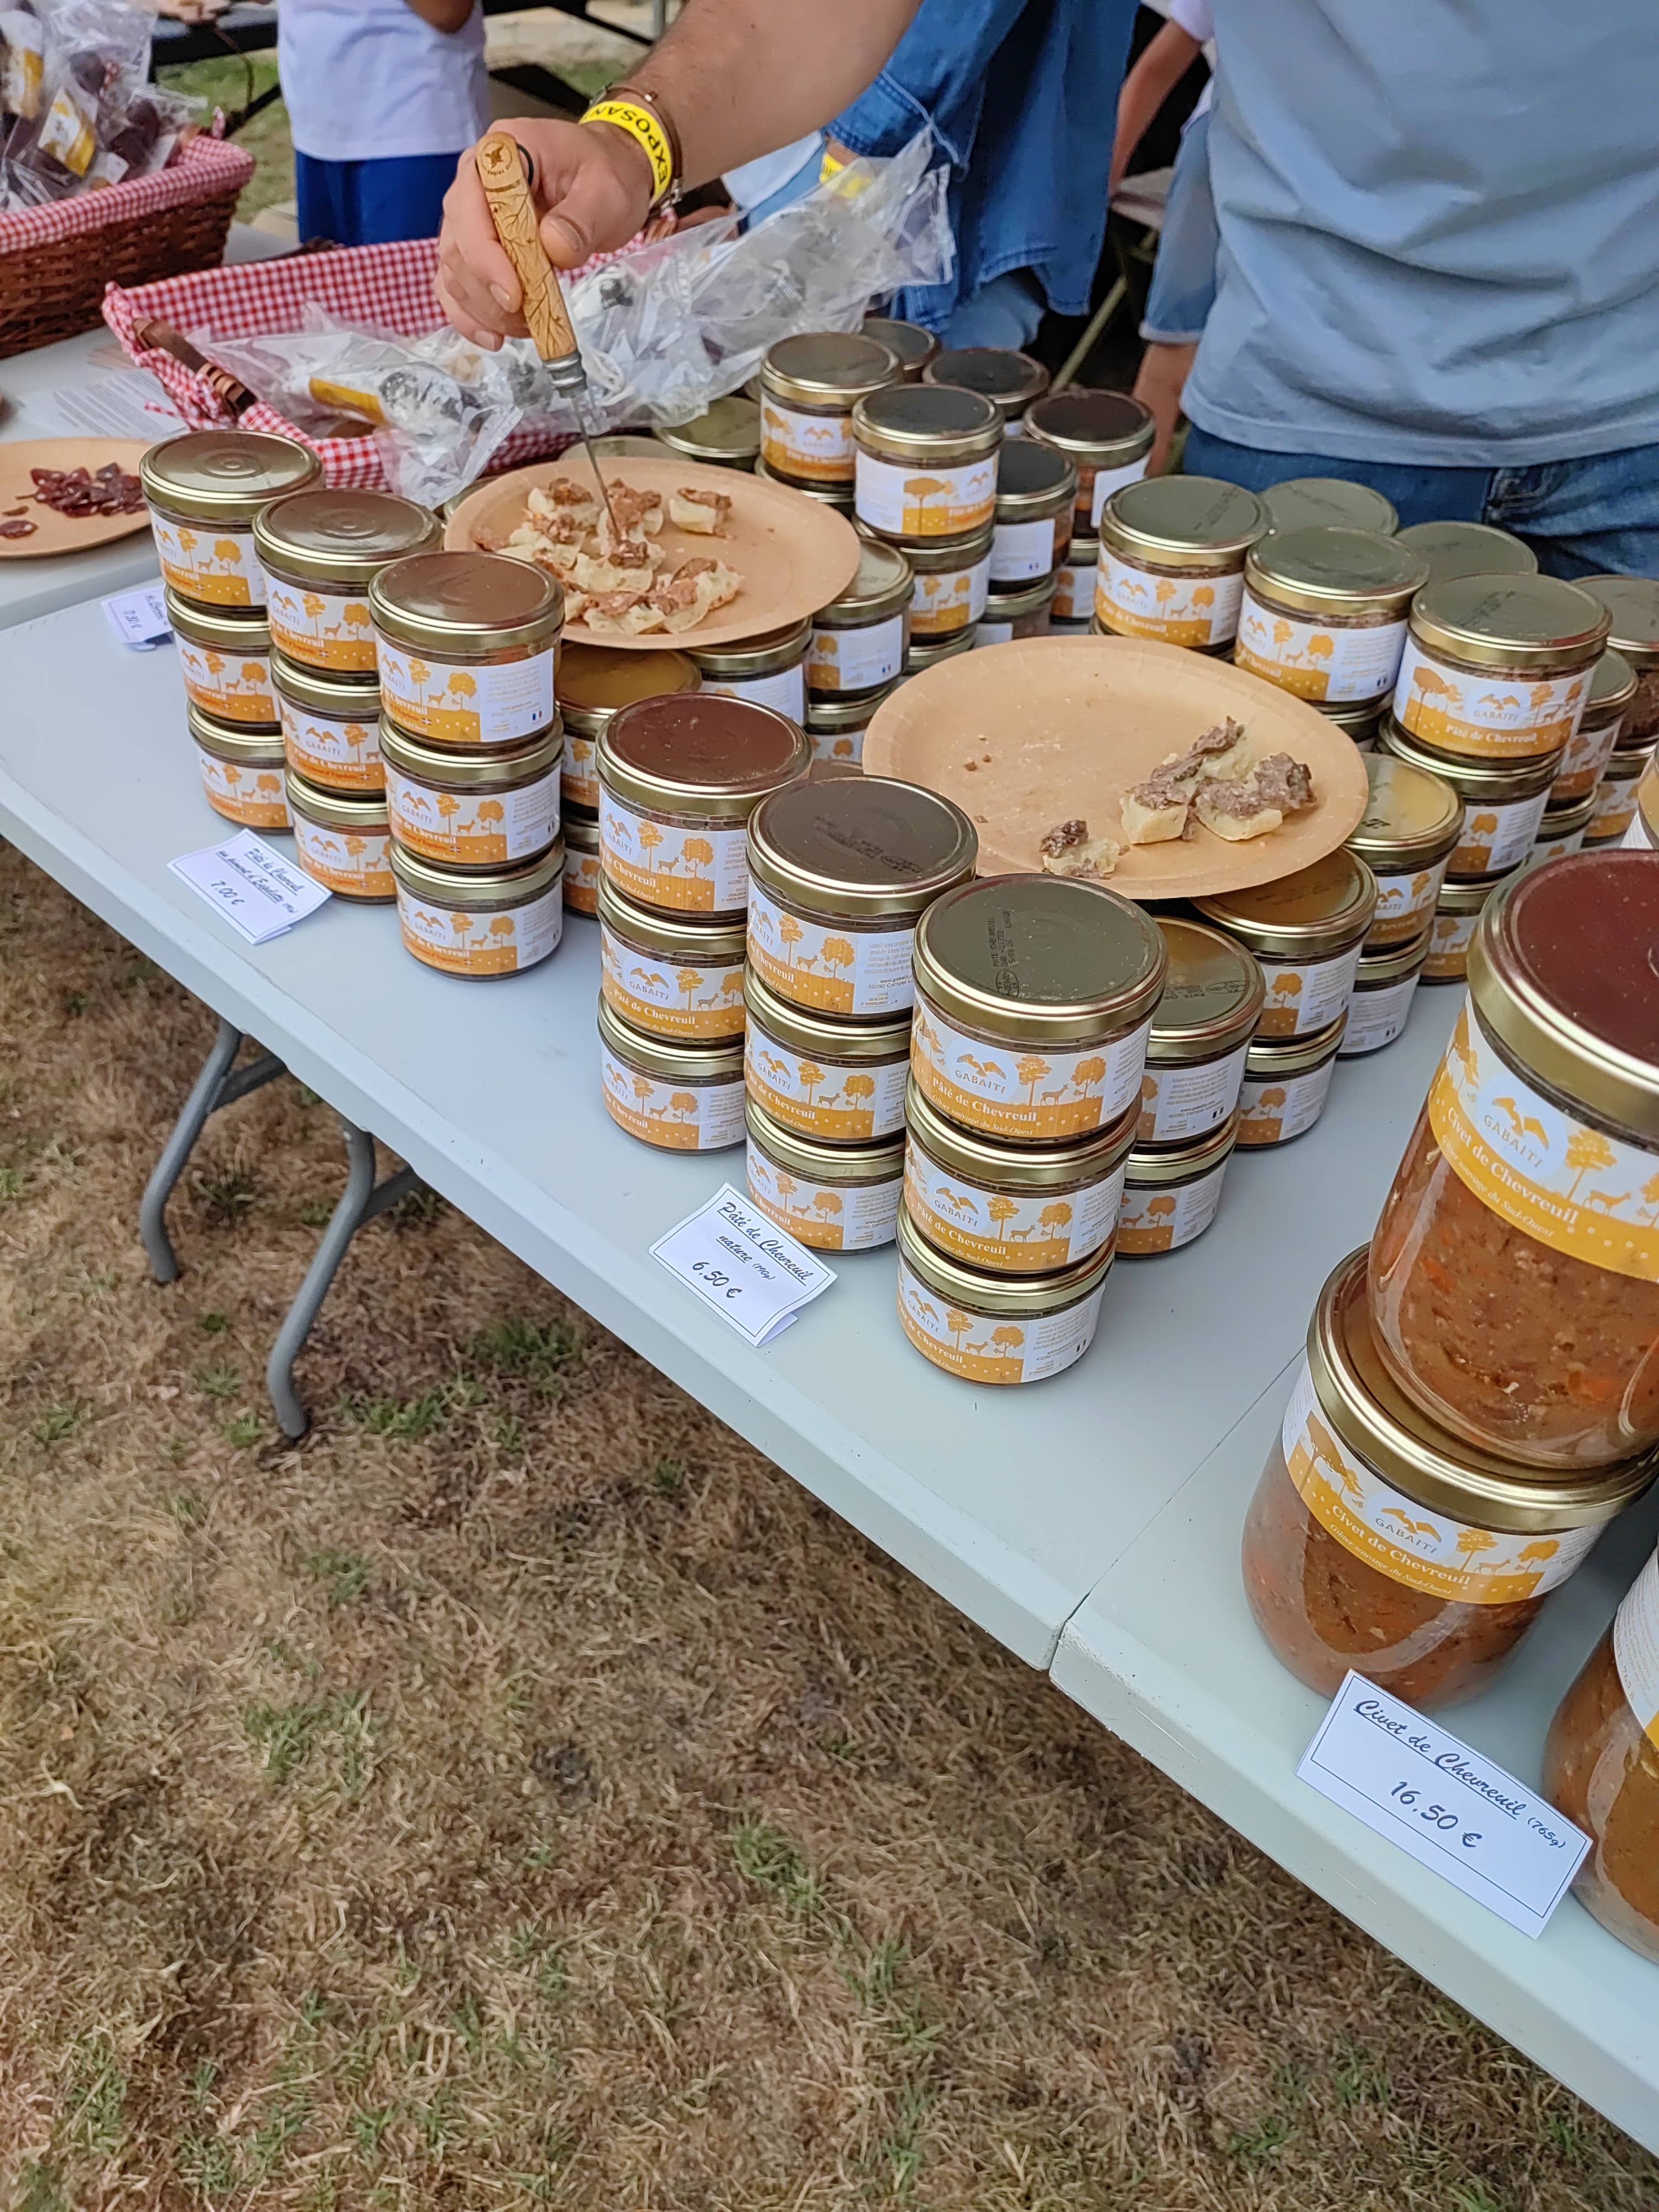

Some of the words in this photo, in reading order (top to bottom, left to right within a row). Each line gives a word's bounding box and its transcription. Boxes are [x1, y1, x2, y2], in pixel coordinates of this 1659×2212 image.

[586, 106, 669, 186] EXPOSAN
[1485, 732, 1538, 743] Chevreuil
[614, 859, 656, 888] Chevreuil
[750, 916, 773, 947] ABAITI
[757, 948, 794, 983] Chevreuil
[614, 988, 630, 1006] Pâté
[632, 1001, 641, 1013] de
[644, 1007, 695, 1025] Chevreuil
[629, 981, 669, 1000] GABAITI
[758, 1062, 790, 1090] GABAITI
[955, 1070, 1005, 1094] GABAITI
[758, 1084, 767, 1095] de
[768, 1092, 815, 1120] Chevreuil
[932, 1076, 953, 1098] Pâté
[955, 1093, 969, 1106] de
[972, 1100, 1037, 1122] Chevreuil
[932, 1094, 951, 1110] Gibier
[951, 1109, 979, 1124] sauvage
[980, 1120, 990, 1128] du
[992, 1124, 1034, 1135] Sud-Ouest
[1484, 1114, 1543, 1168] GABAITI
[1448, 1107, 1472, 1148] Civet
[1472, 1145, 1489, 1166] de
[1490, 1162, 1579, 1225] Chevreuil
[934, 1199, 978, 1227] GABAITI
[1459, 1160, 1488, 1192] sauvage
[1488, 1191, 1501, 1204] du
[1501, 1200, 1554, 1238] Sud-Ouest
[720, 1201, 749, 1228] Pâté
[747, 1227, 761, 1239] de
[759, 1239, 814, 1281] Chevreuil
[917, 1202, 933, 1224] Pâté
[935, 1222, 946, 1233] de
[948, 1229, 1006, 1255] Chevreuil
[719, 1235, 753, 1262] nature
[966, 1252, 1003, 1267] Sud-Ouest
[692, 1261, 729, 1287] 6.50
[726, 1288, 742, 1298] €
[907, 1300, 938, 1333] GABAITI
[916, 1330, 963, 1364] Chevreuil
[1332, 1505, 1366, 1538] Civet
[1368, 1537, 1387, 1553] de
[1390, 1549, 1471, 1585] Chevreuil
[1375, 1517, 1437, 1554] GABAITI
[1330, 1524, 1354, 1546] Gibier
[1354, 1546, 1389, 1571] sauvage
[1389, 1567, 1401, 1577] du
[1402, 1573, 1452, 1595] Sud-Ouest
[1622, 1665, 1632, 1690] 765
[1355, 1699, 1406, 1735] Civet
[1408, 1735, 1431, 1752] de
[1435, 1752, 1526, 1817] Chevreuil
[1527, 1817, 1567, 1849] (765g)
[1390, 1780, 1459, 1830] 16.50
[1462, 1832, 1483, 1848] €
